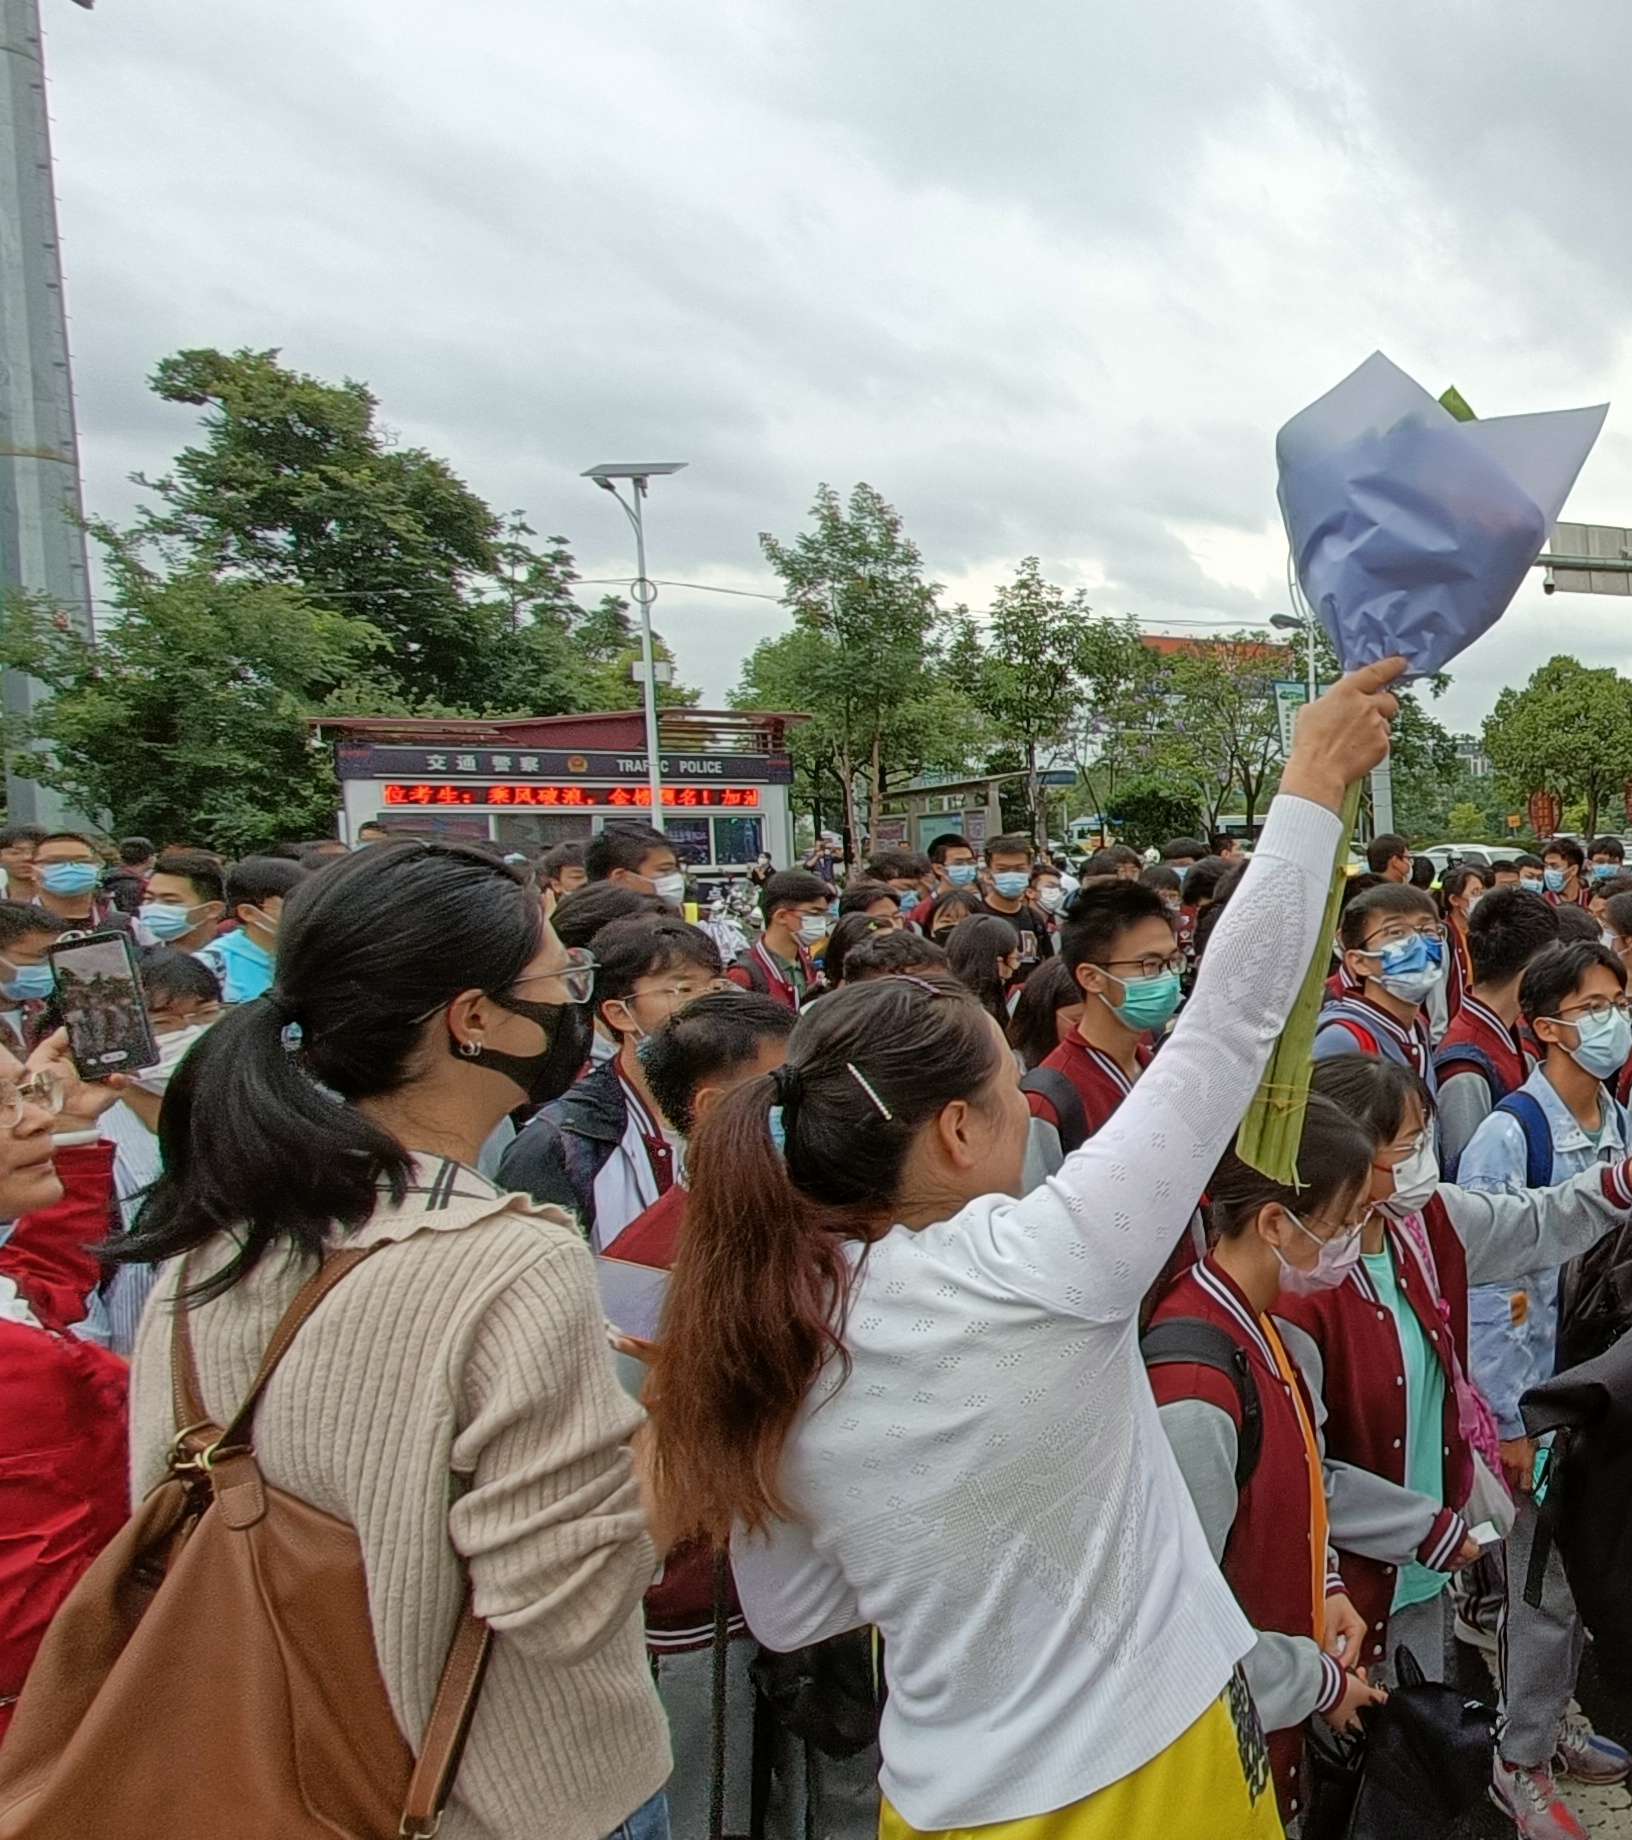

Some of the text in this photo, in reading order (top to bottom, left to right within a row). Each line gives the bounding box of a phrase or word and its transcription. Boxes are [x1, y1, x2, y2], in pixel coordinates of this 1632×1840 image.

[427, 755, 540, 772] 交通警察
[617, 759, 723, 774] TRAFC POLICE
